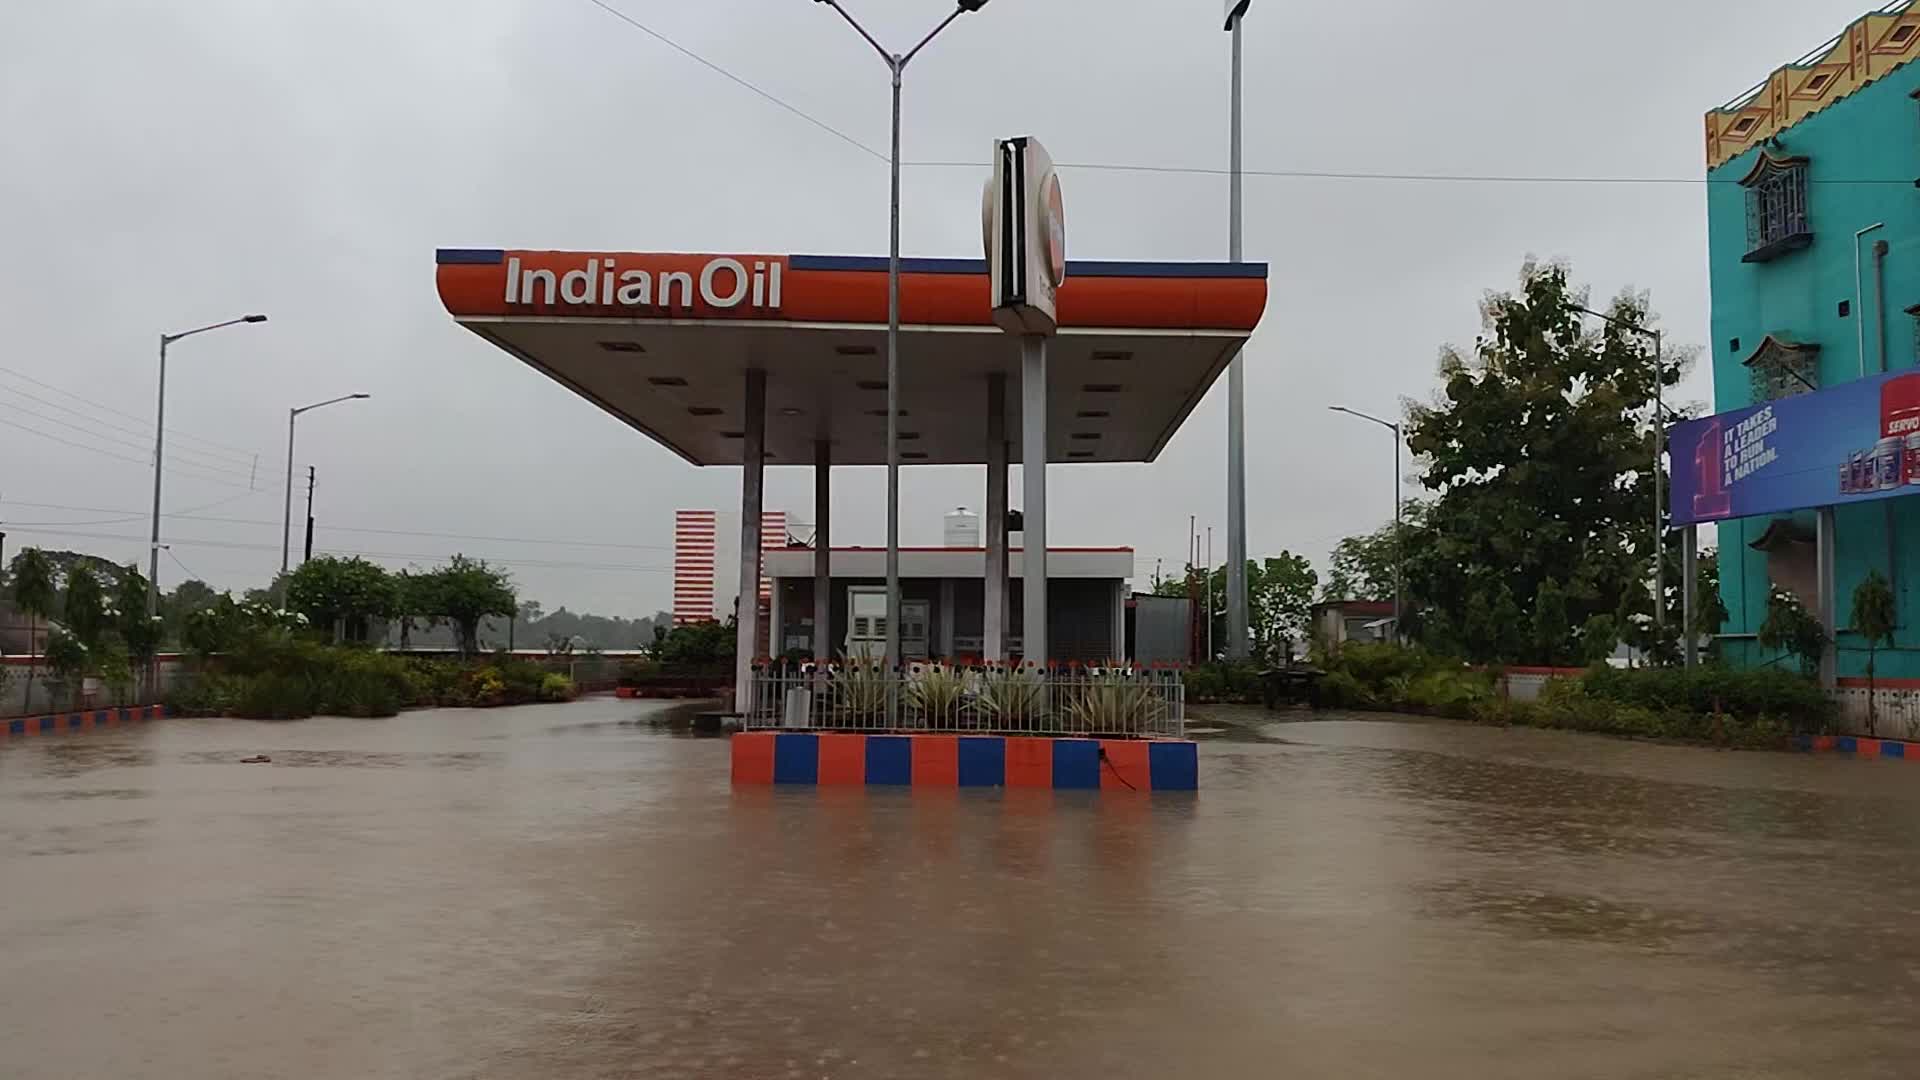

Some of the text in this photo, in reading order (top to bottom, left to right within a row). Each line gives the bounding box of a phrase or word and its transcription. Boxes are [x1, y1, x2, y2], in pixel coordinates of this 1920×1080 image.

[505, 257, 782, 307] IndianOil
[1724, 406, 1772, 444] IT TAKES
[1724, 418, 1776, 459] A LEADER
[1888, 417, 1919, 433] SERVO
[1724, 440, 1764, 472] TO RUN
[1724, 472, 1733, 487] A
